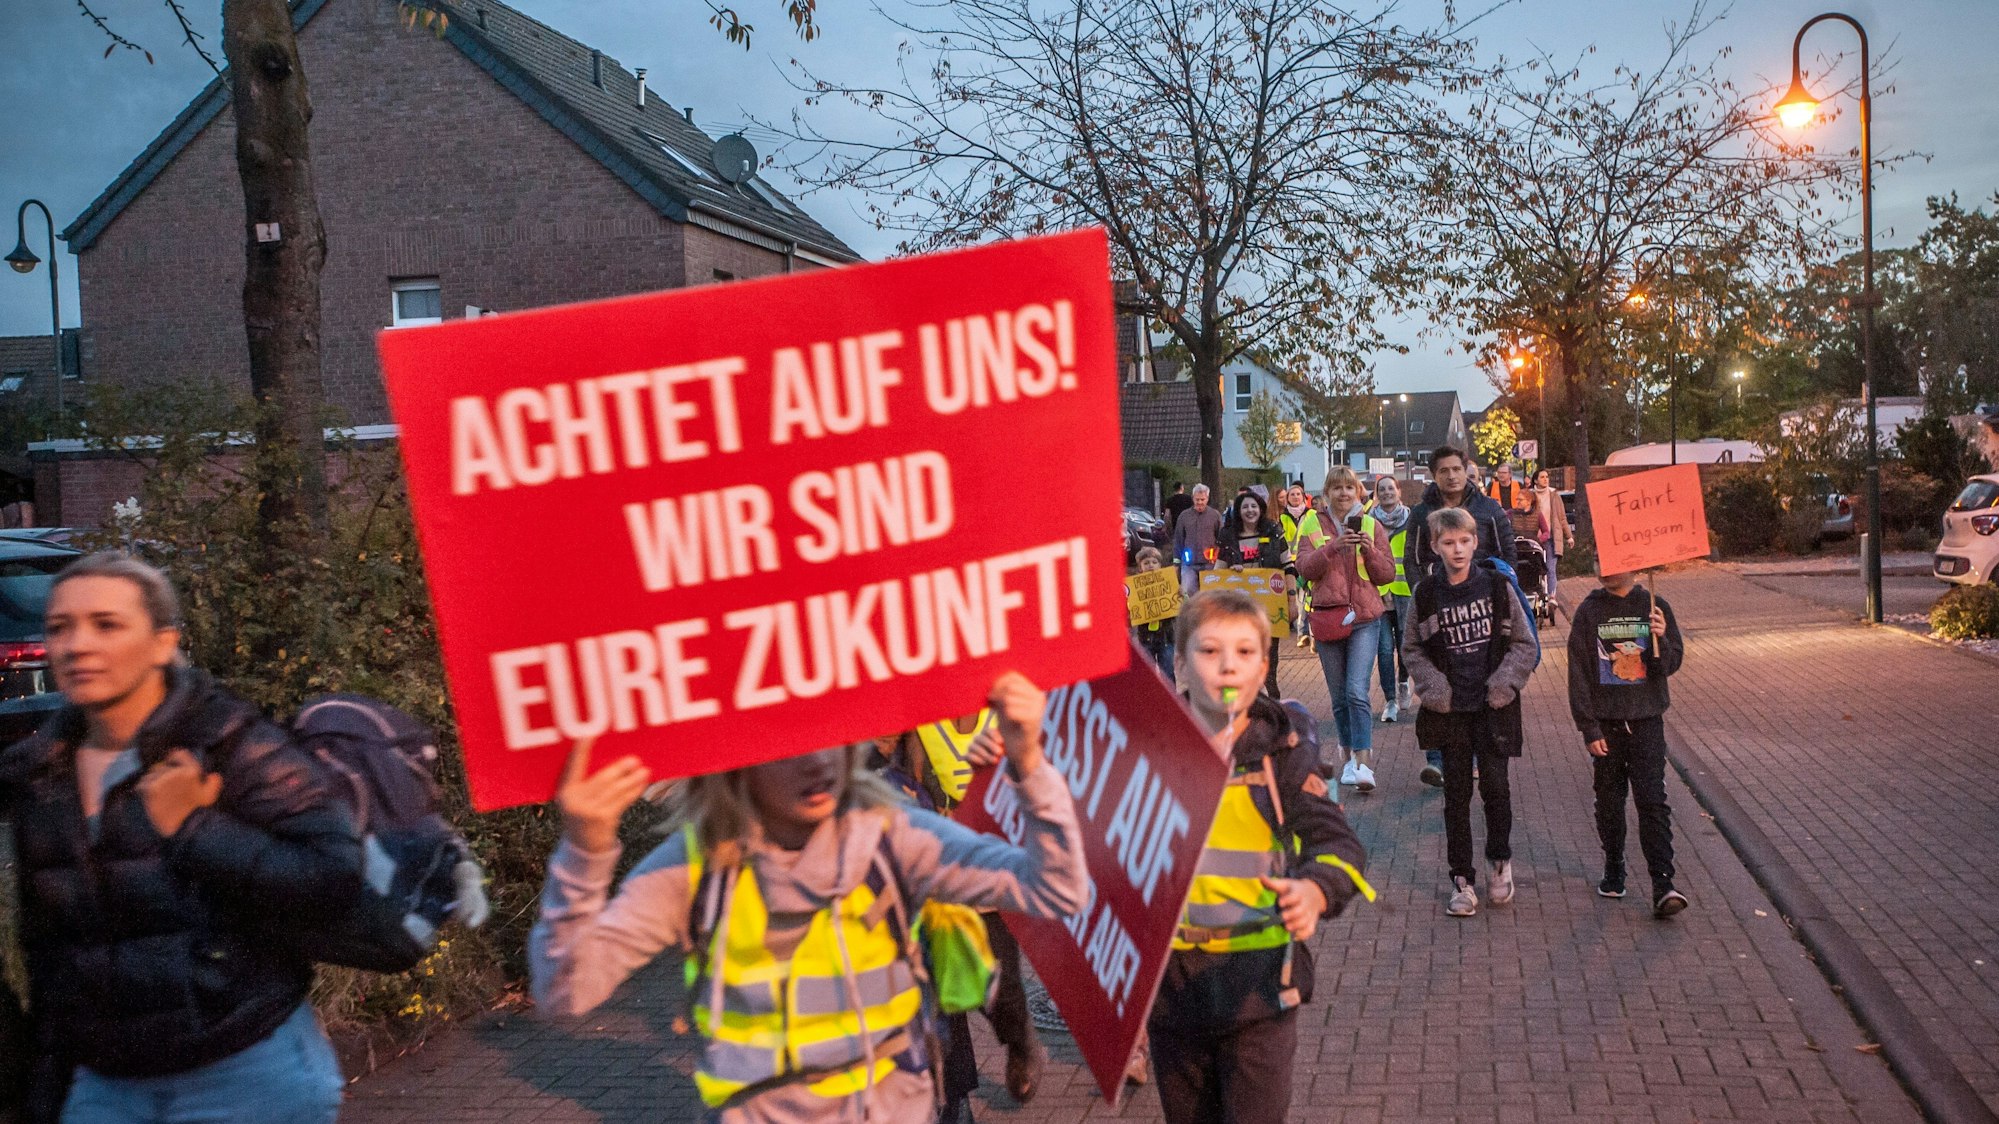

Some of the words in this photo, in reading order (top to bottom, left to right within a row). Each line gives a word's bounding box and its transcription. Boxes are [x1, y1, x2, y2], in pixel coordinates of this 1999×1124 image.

[450, 356, 748, 497] ACHTET
[769, 330, 903, 445] AUF
[917, 300, 1078, 415] UNS!
[623, 484, 781, 593] WIR
[788, 450, 955, 564] SIND
[1608, 482, 1675, 515] Fahrt
[1133, 571, 1165, 589] FREIE
[1137, 580, 1172, 602] BAHN
[1270, 579, 1286, 588] STOP
[489, 617, 722, 752] EURE
[723, 536, 1092, 712] ZUKUNFT!
[1041, 679, 1129, 822] ASST
[1105, 753, 1190, 907] AUF
[1084, 901, 1142, 1019] AUF!
